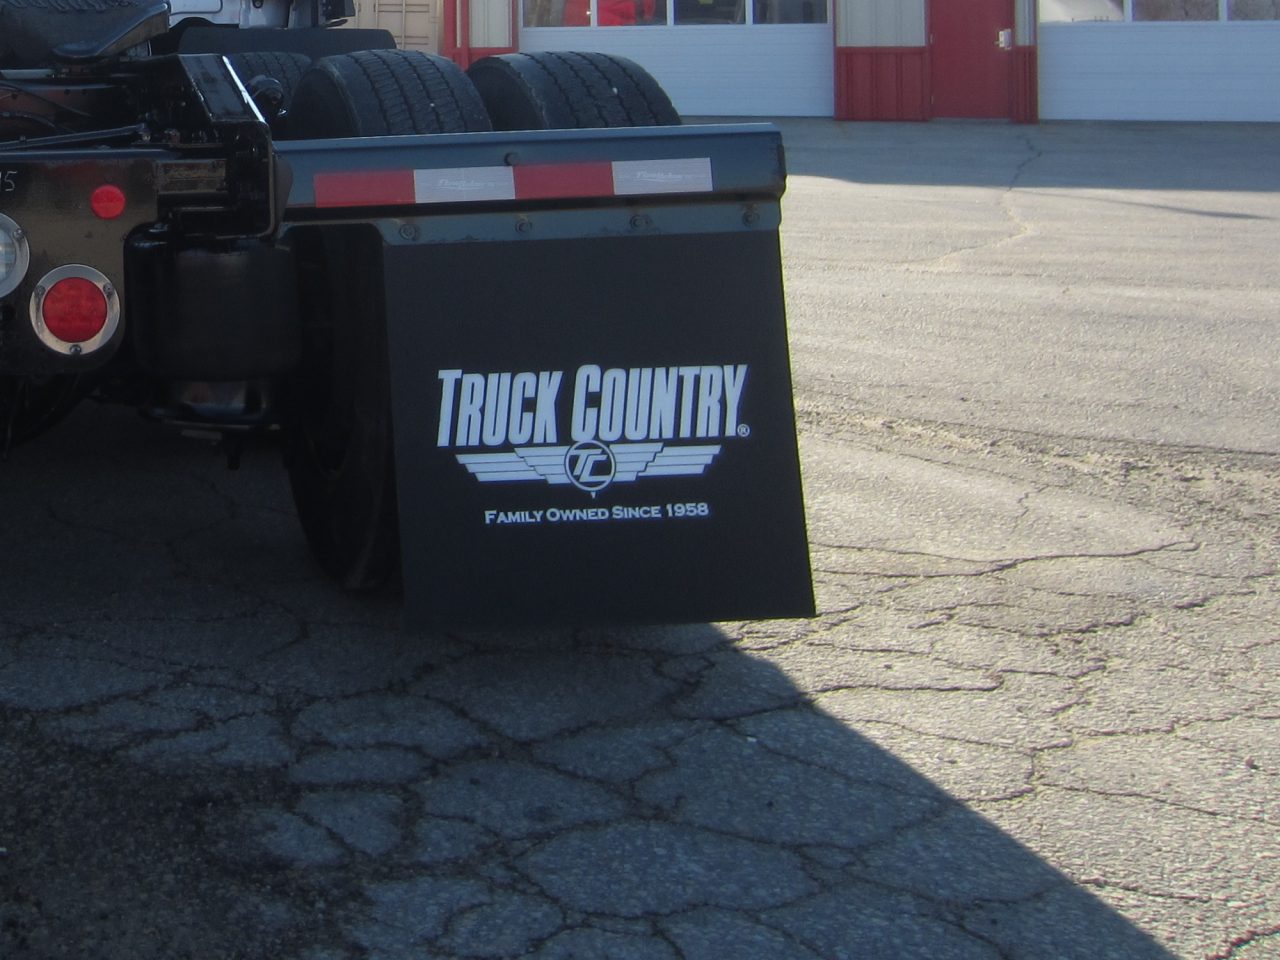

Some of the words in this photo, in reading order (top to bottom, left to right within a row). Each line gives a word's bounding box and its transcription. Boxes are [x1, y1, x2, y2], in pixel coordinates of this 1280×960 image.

[437, 368, 563, 447] TRUCK
[570, 364, 749, 442] COUNTRY
[484, 509, 544, 524] FAMILY
[545, 507, 609, 521] OWNED
[611, 505, 662, 519] SINCE
[665, 502, 709, 517] 1958
